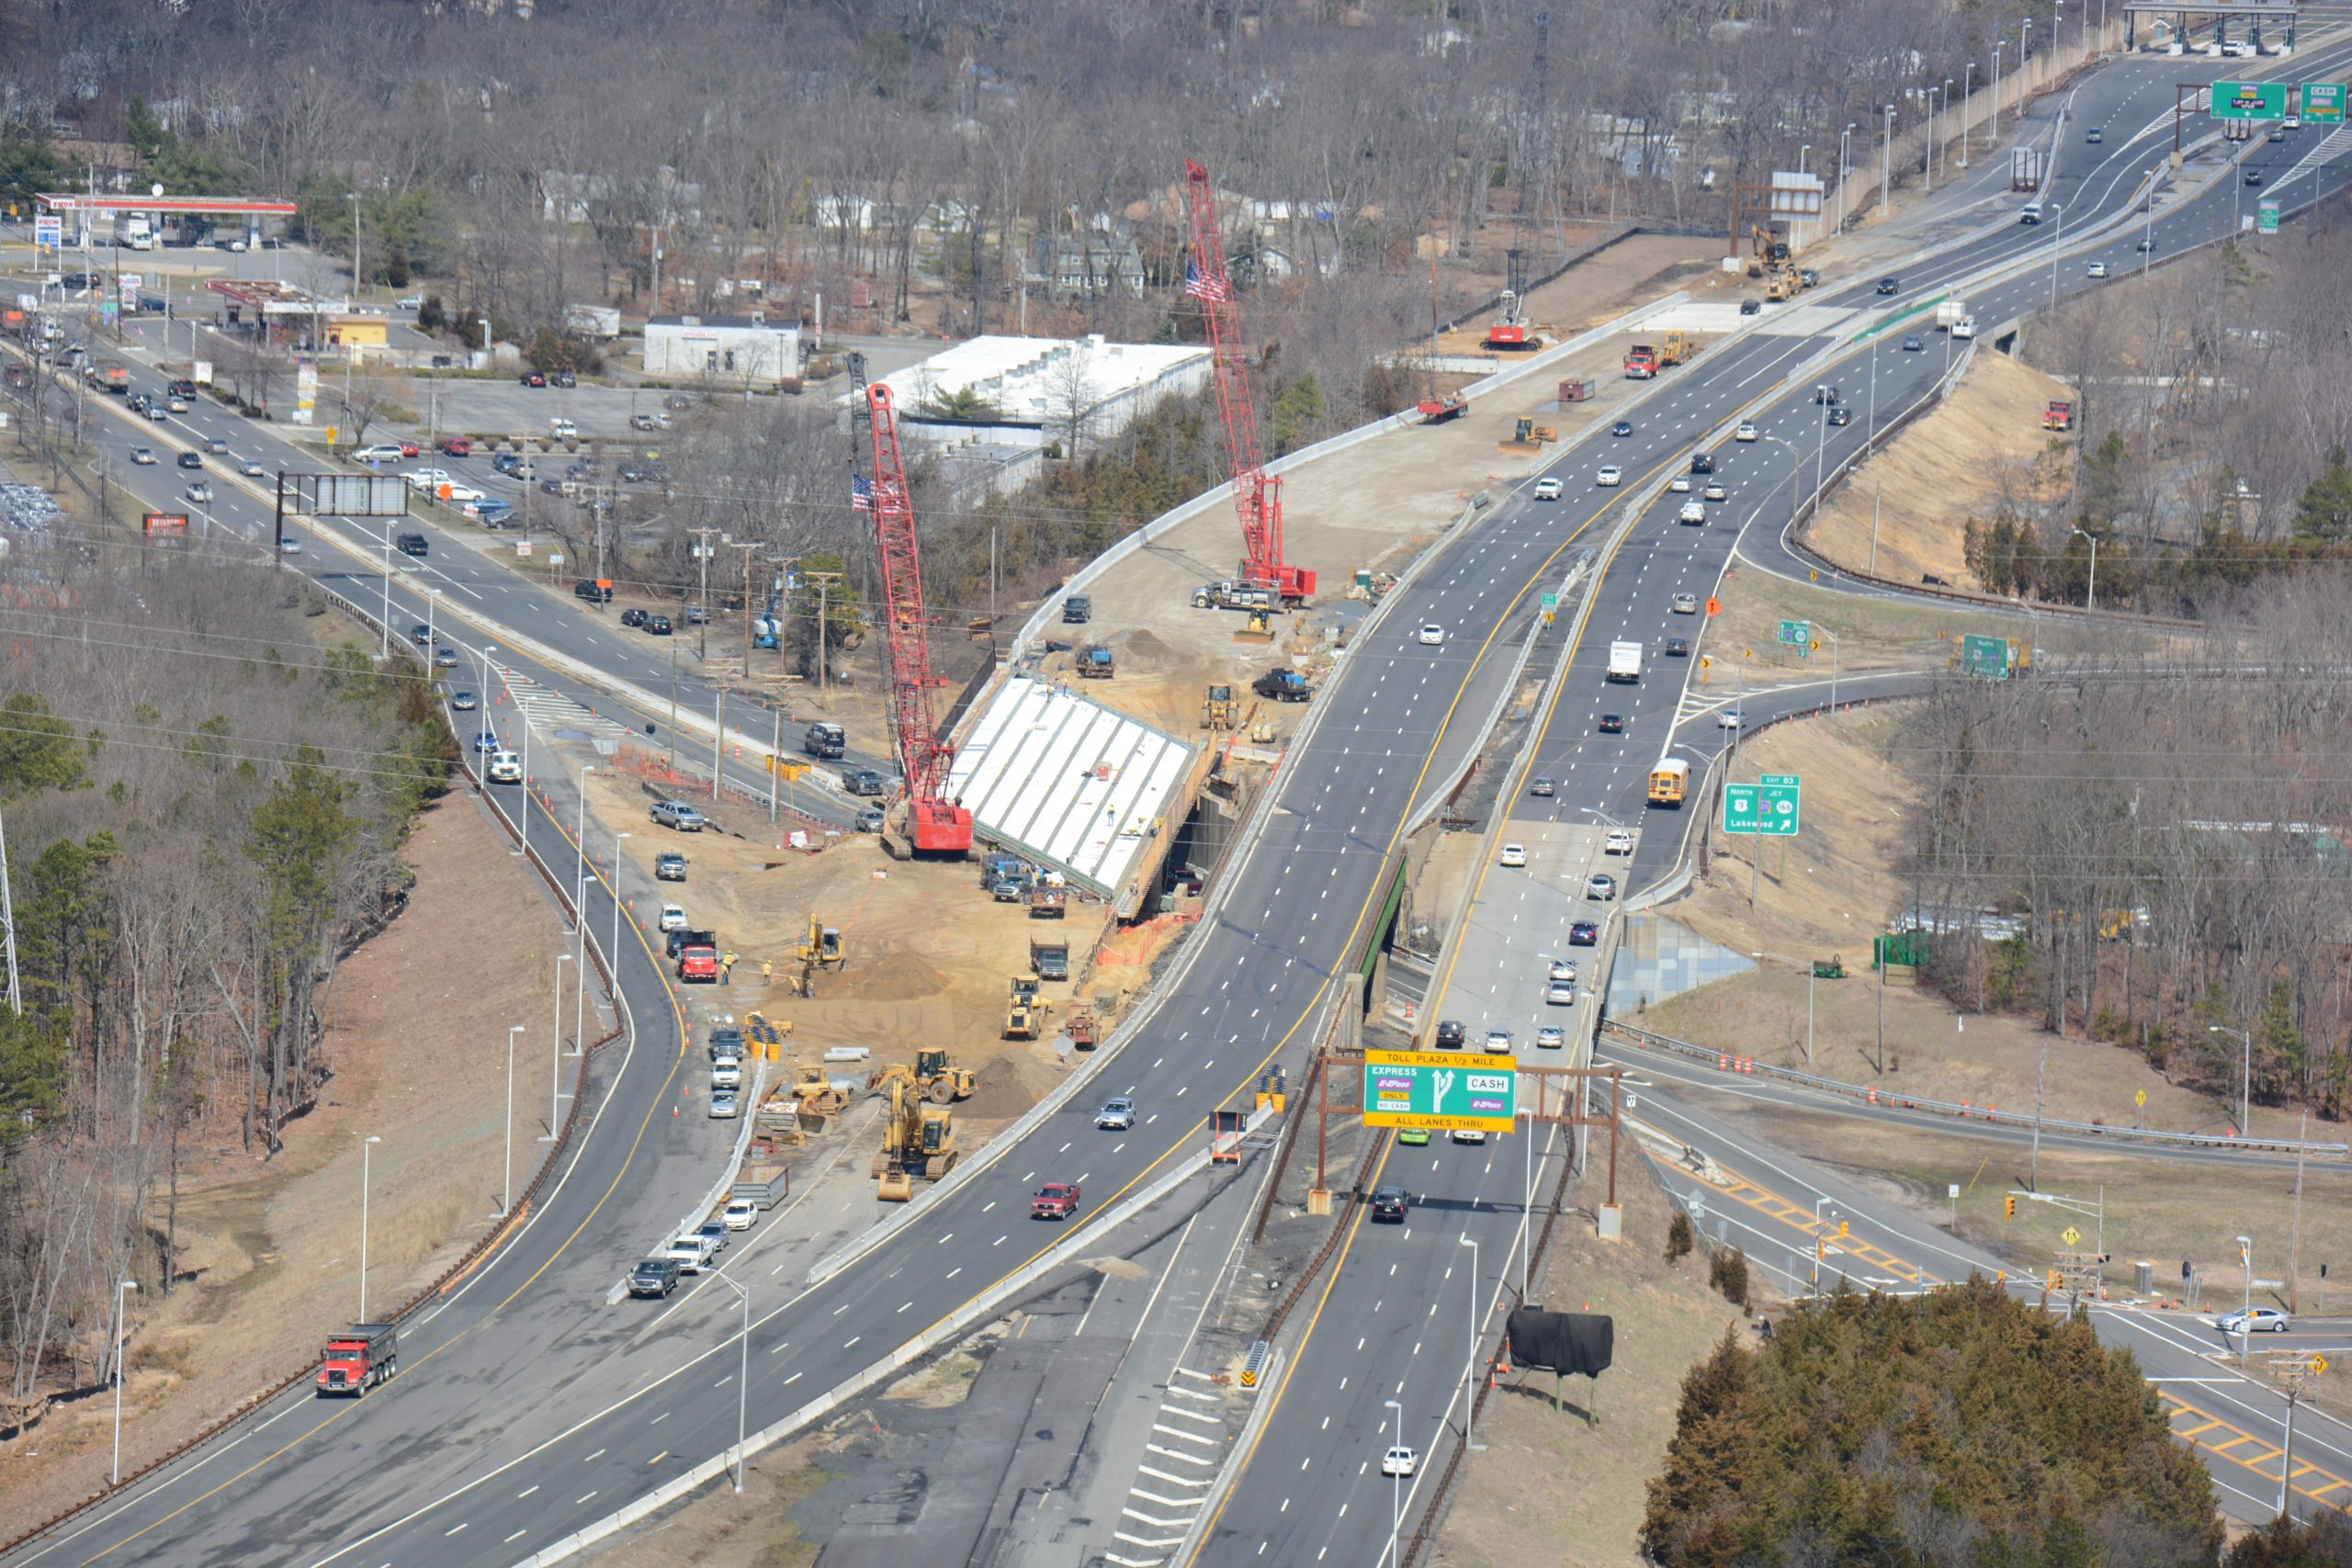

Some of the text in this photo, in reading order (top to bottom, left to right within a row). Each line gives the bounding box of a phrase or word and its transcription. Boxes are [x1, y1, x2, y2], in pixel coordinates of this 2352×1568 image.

[1730, 788, 1753, 796] NORTH
[1387, 1054, 1410, 1062] TOLL
[1416, 1055, 1448, 1064] PLAZA
[1372, 1066, 1418, 1077] EXPRESS
[1471, 1078, 1505, 1089] CASH
[1396, 1117, 1484, 1128] ALL LANES THRU
